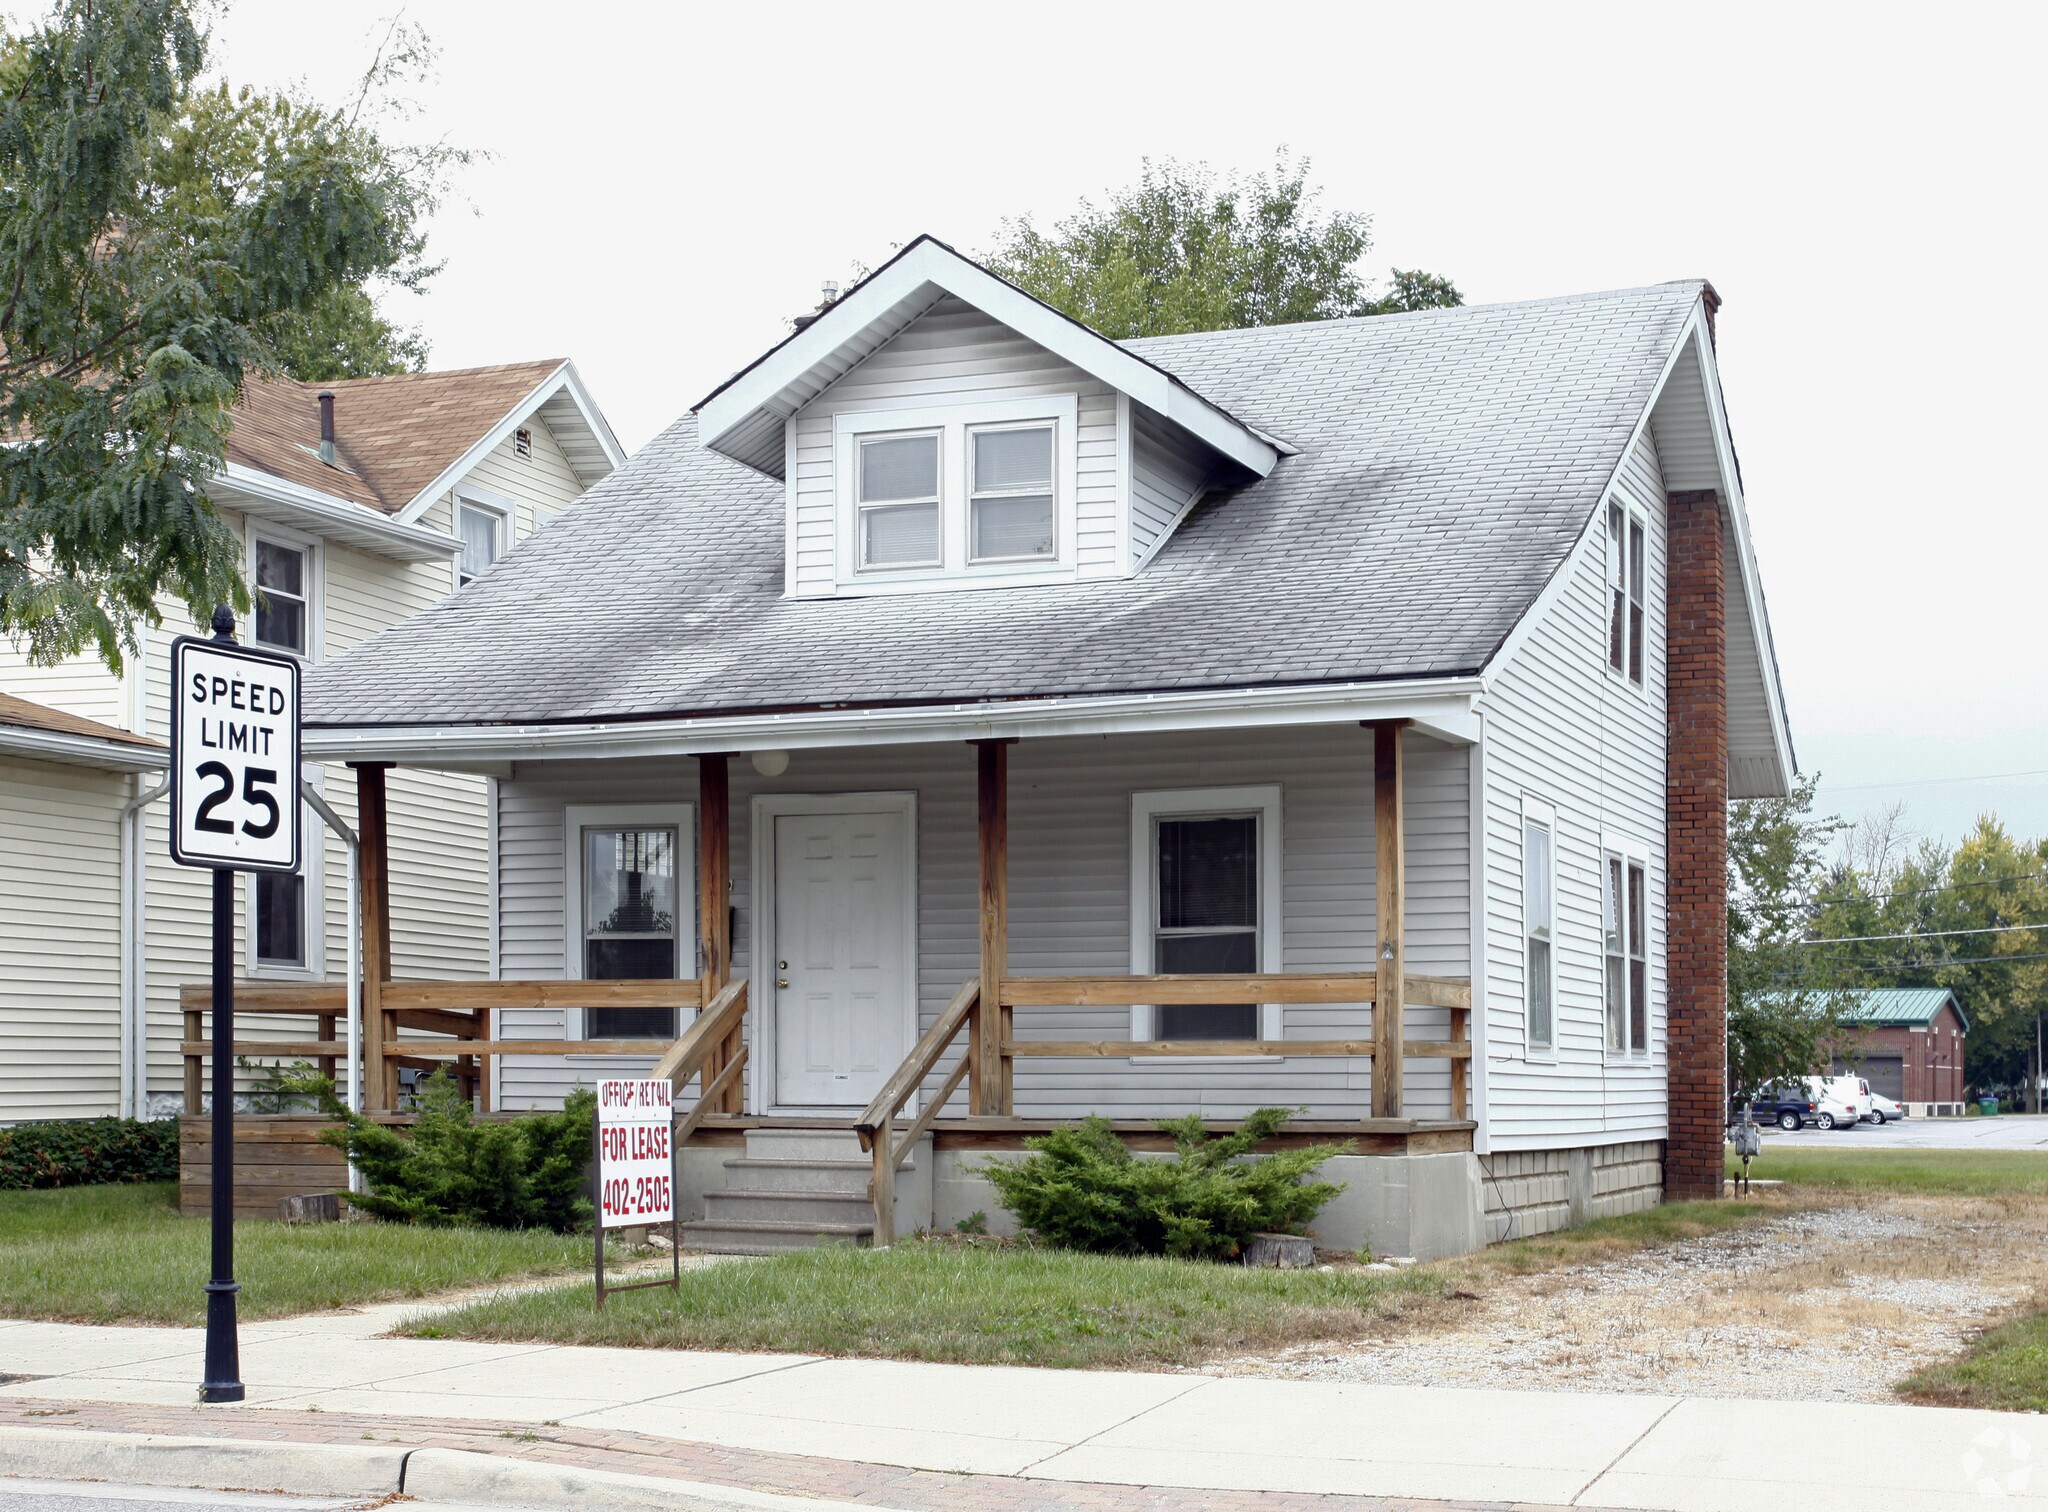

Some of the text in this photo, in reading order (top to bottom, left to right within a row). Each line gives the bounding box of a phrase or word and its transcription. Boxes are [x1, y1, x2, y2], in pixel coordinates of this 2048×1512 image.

[191, 672, 285, 716] SPEED
[202, 717, 274, 756] LIMIT
[194, 760, 280, 839] 25
[602, 1126, 669, 1162] FOR LEASE
[603, 1176, 670, 1216] 402-2505
